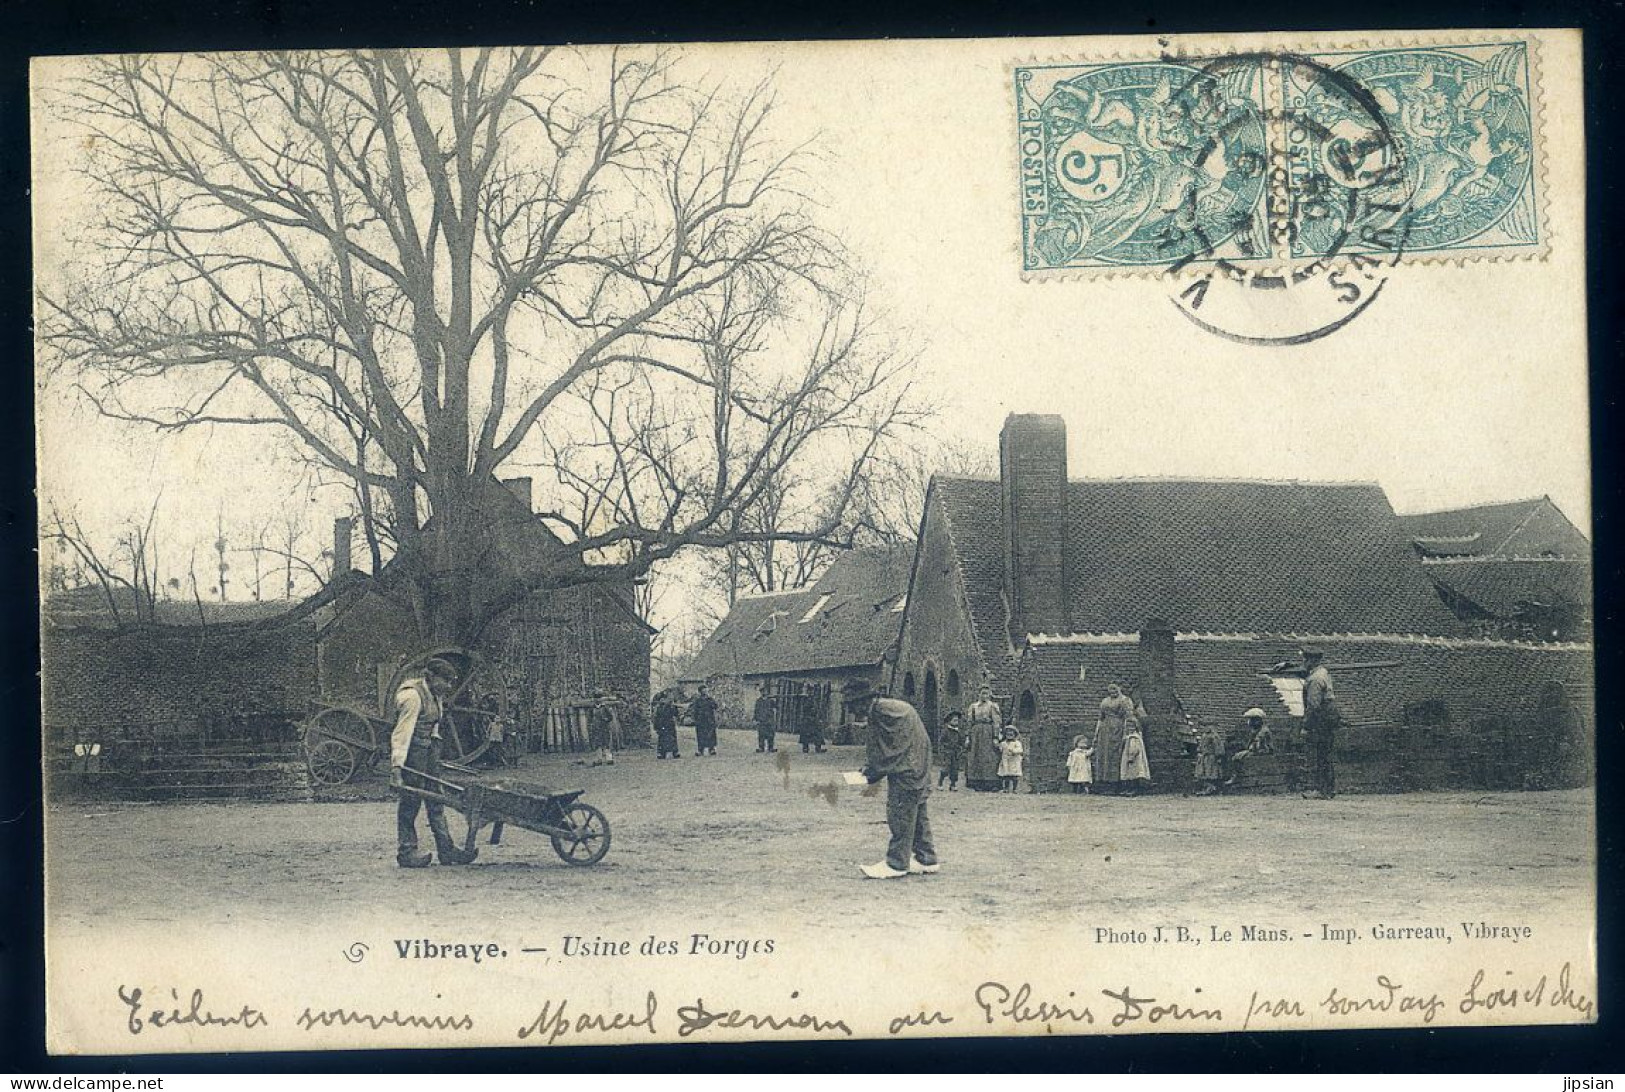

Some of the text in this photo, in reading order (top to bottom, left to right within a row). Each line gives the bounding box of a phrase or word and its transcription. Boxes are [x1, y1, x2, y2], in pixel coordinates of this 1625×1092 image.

[1022, 123, 1046, 212] POSTES
[393, 933, 775, 964] Vibraye. Usine des Forges
[1094, 926, 1147, 944] Photo
[1153, 926, 1168, 943] J.
[1210, 925, 1232, 942] Le
[1241, 925, 1294, 942] Mans.
[1321, 923, 1362, 945] Imp.
[1371, 923, 1452, 944] Garreau,
[1460, 921, 1532, 944] Vibraye
[517, 991, 658, 1044] Marcel
[974, 981, 1095, 1024] Plessis
[1101, 986, 1222, 1027] Dorin
[1243, 991, 1305, 1031] par
